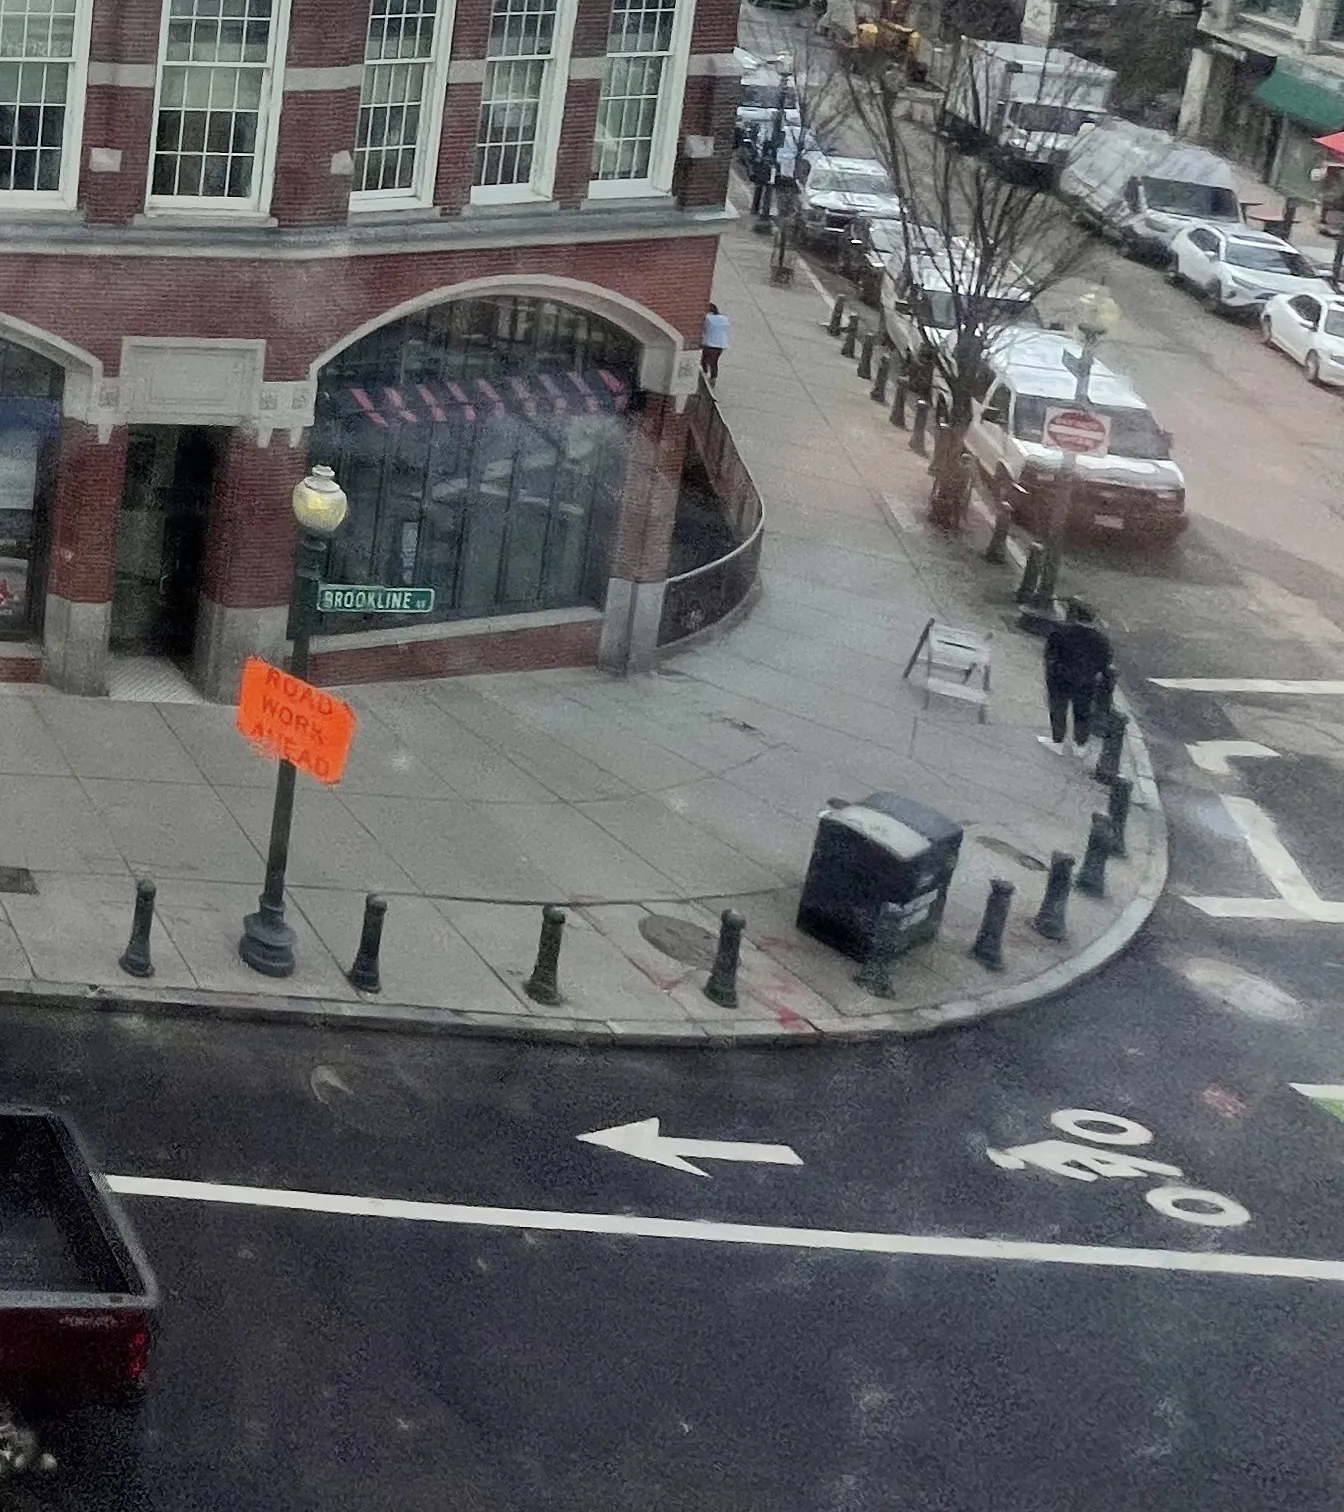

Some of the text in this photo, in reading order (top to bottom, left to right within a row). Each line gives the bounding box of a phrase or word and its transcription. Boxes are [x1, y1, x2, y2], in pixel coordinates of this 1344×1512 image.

[323, 590, 412, 609] BROOKLINE
[265, 668, 333, 716] ROAD
[261, 694, 324, 747] WORK
